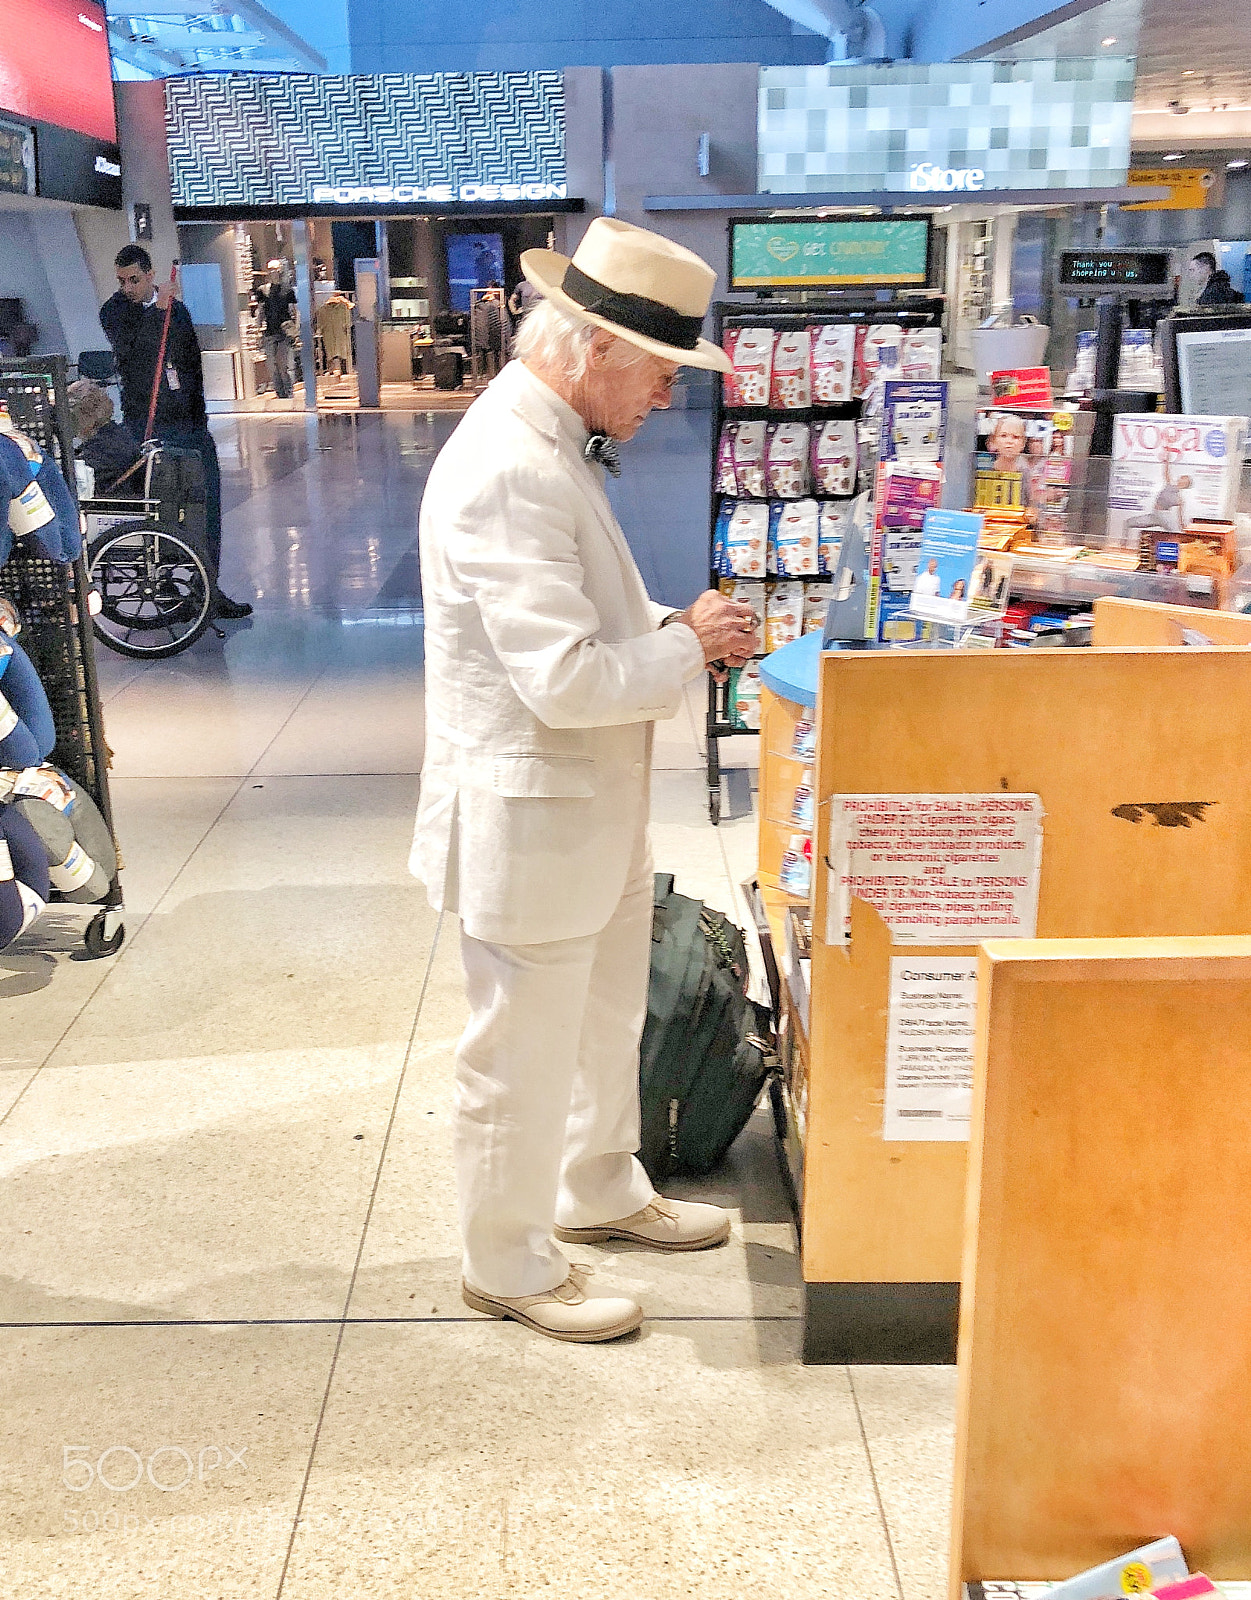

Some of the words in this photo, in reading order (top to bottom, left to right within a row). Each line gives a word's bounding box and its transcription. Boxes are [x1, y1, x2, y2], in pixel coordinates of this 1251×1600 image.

[910, 162, 985, 192] iStore
[313, 185, 452, 203] PORSCHE
[459, 183, 568, 201] DESIGN
[1072, 260, 1094, 268] Thank
[1099, 261, 1113, 269] you
[1071, 269, 1107, 278] shopping
[1116, 424, 1204, 462] yoga
[842, 800, 912, 812] PROHIBITED
[914, 800, 932, 812] for
[934, 801, 963, 812] SALE
[979, 801, 1033, 812] PERSONS
[857, 813, 897, 825] UNDER
[858, 827, 906, 839] chewing
[957, 827, 1015, 839] powdered
[895, 839, 926, 850] other
[927, 839, 972, 850] tobacco
[974, 839, 1026, 853] products
[870, 853, 883, 862] or
[884, 851, 942, 862] electronic
[944, 852, 1000, 865] cigarettes
[923, 864, 946, 875] and
[841, 876, 909, 887] PROHIBITED
[911, 876, 928, 887] for
[929, 876, 959, 887] SALE
[961, 878, 973, 887] to
[974, 876, 1028, 887] PERSONS
[908, 887, 976, 900] Non-tobacco
[978, 900, 1013, 915] rolling
[894, 913, 941, 927] smoking
[900, 969, 967, 981] Consumer
